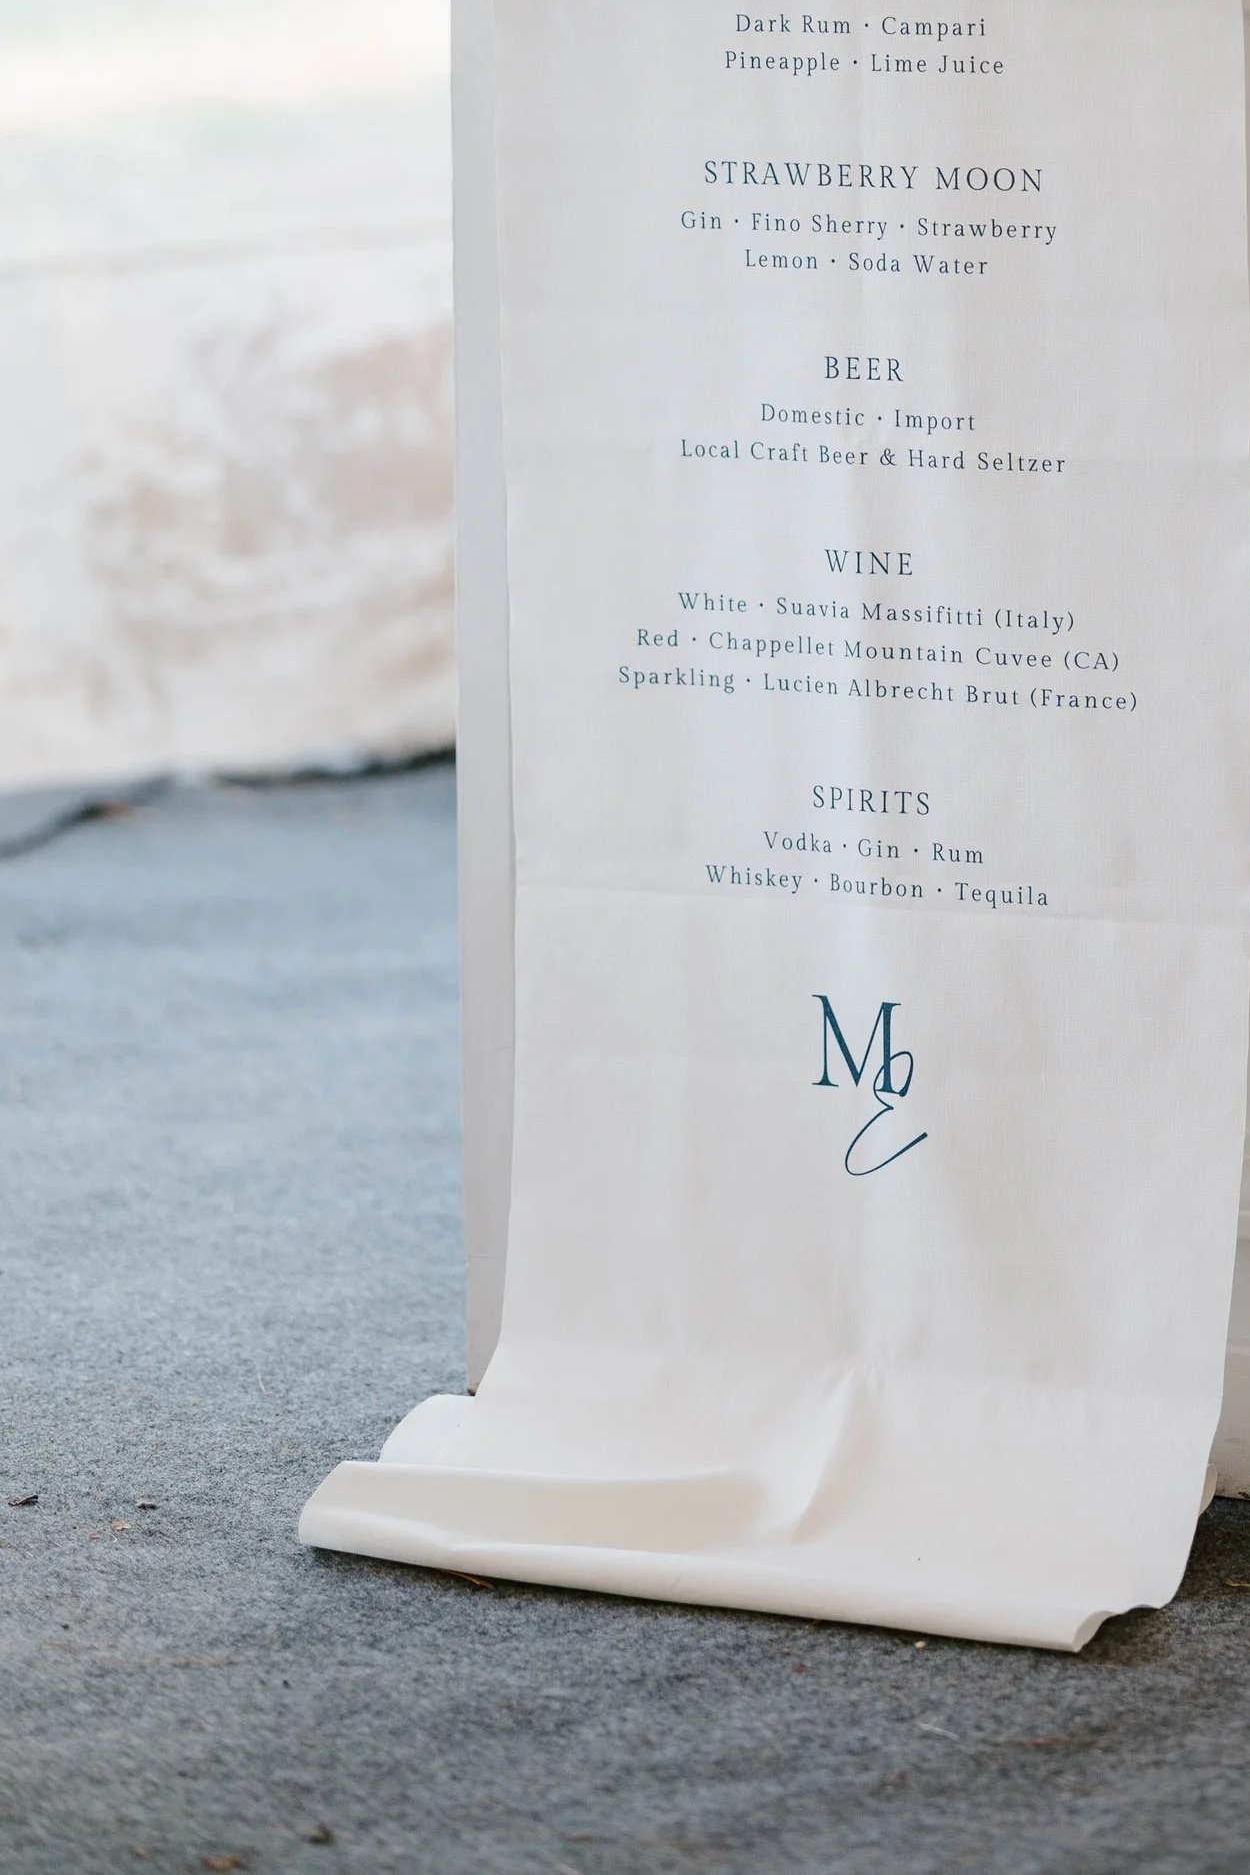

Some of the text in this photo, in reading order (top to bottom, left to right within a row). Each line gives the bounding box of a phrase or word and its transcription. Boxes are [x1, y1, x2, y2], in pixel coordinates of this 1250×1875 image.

[735, 13, 986, 42] Dark Rum Campari
[725, 50, 1004, 77] Pineapple Lime Juice
[704, 160, 1043, 193] STRAWBERRY MOON
[681, 210, 1057, 246] Gin Fino Sherry Strawberry
[745, 248, 989, 275] Lemon Soda Water
[824, 355, 904, 382] BEER
[761, 403, 975, 436] Domestic Import
[681, 438, 1066, 473] Local Craft Beer & Hard Seltzer
[824, 548, 913, 576] WINE
[677, 591, 1074, 636] White Suavia Massifitti (Italy)
[636, 628, 1119, 673] Red Chappellet Mountain Cuvee (CA)
[618, 665, 1137, 712] Sparkling Lucien Albrecht Brut (France)
[812, 784, 930, 816] SPIRITS
[763, 830, 984, 864] Vodka Gin Rum
[705, 864, 1049, 910] Whiskey Bourbon Tequila
